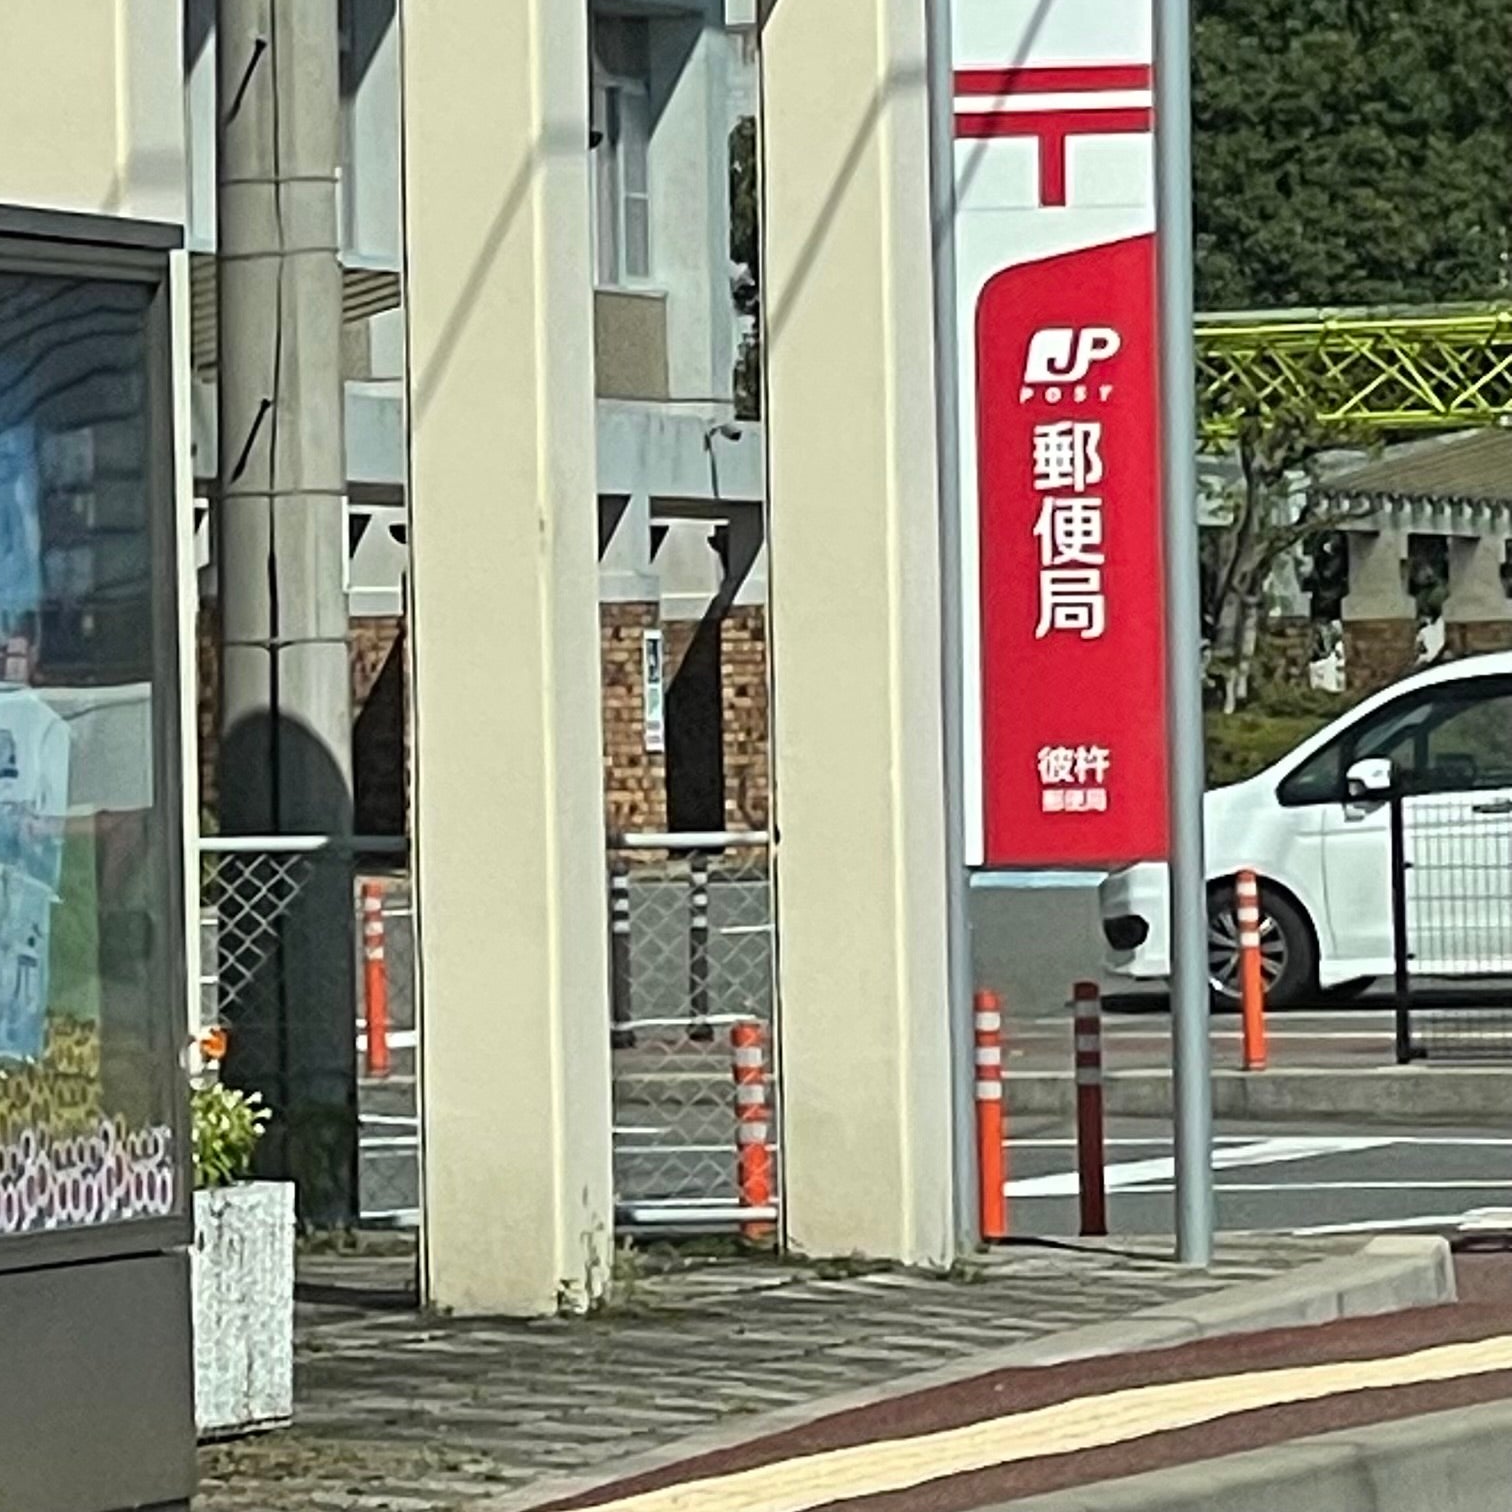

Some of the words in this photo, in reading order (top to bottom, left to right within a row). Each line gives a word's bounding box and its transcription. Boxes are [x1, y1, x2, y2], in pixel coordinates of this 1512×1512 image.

[1019, 384, 1113, 404] POST
[1032, 419, 1106, 639] 郵便局
